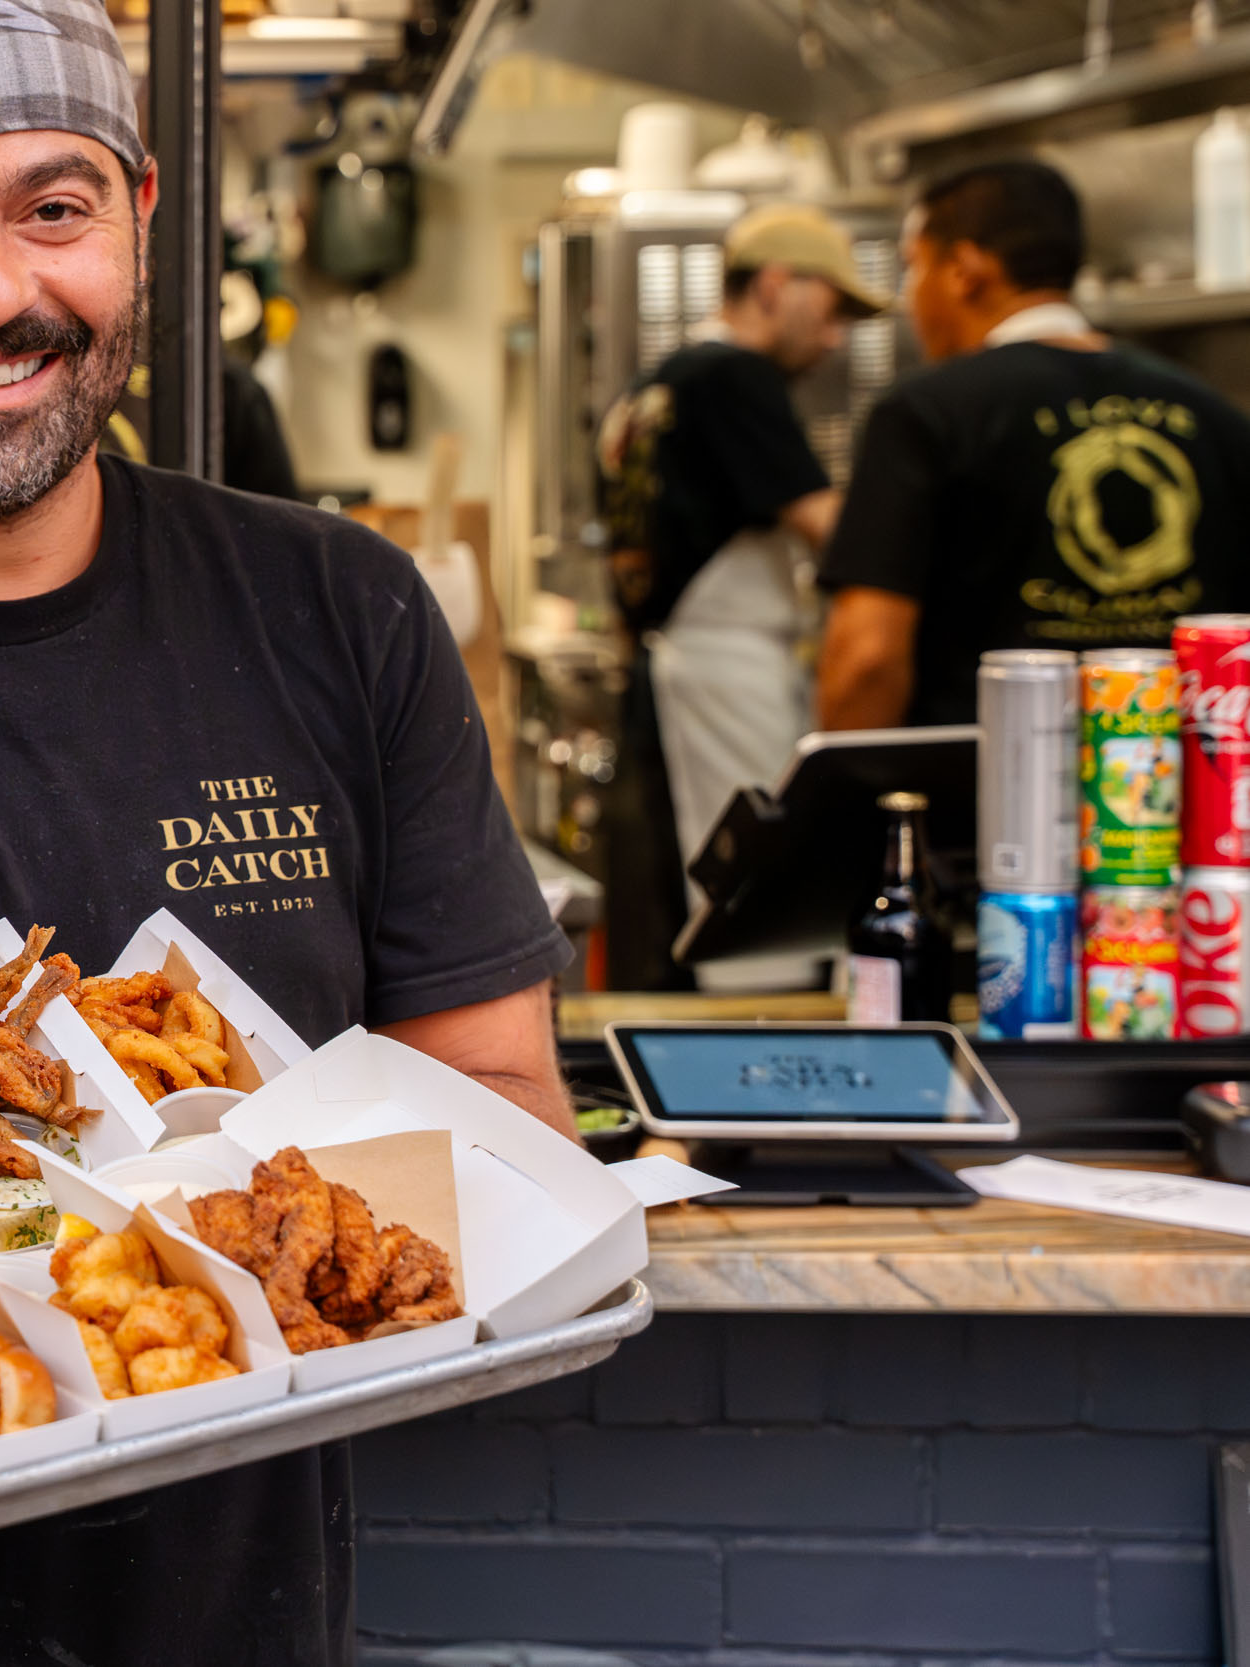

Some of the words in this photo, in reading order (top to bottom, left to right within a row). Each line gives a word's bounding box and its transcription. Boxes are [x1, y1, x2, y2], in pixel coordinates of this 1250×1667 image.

[200, 775, 277, 801] THE
[157, 804, 322, 851] DAILY
[165, 847, 331, 891] CATCH
[213, 901, 265, 917] EST.
[271, 896, 315, 913] 1973
